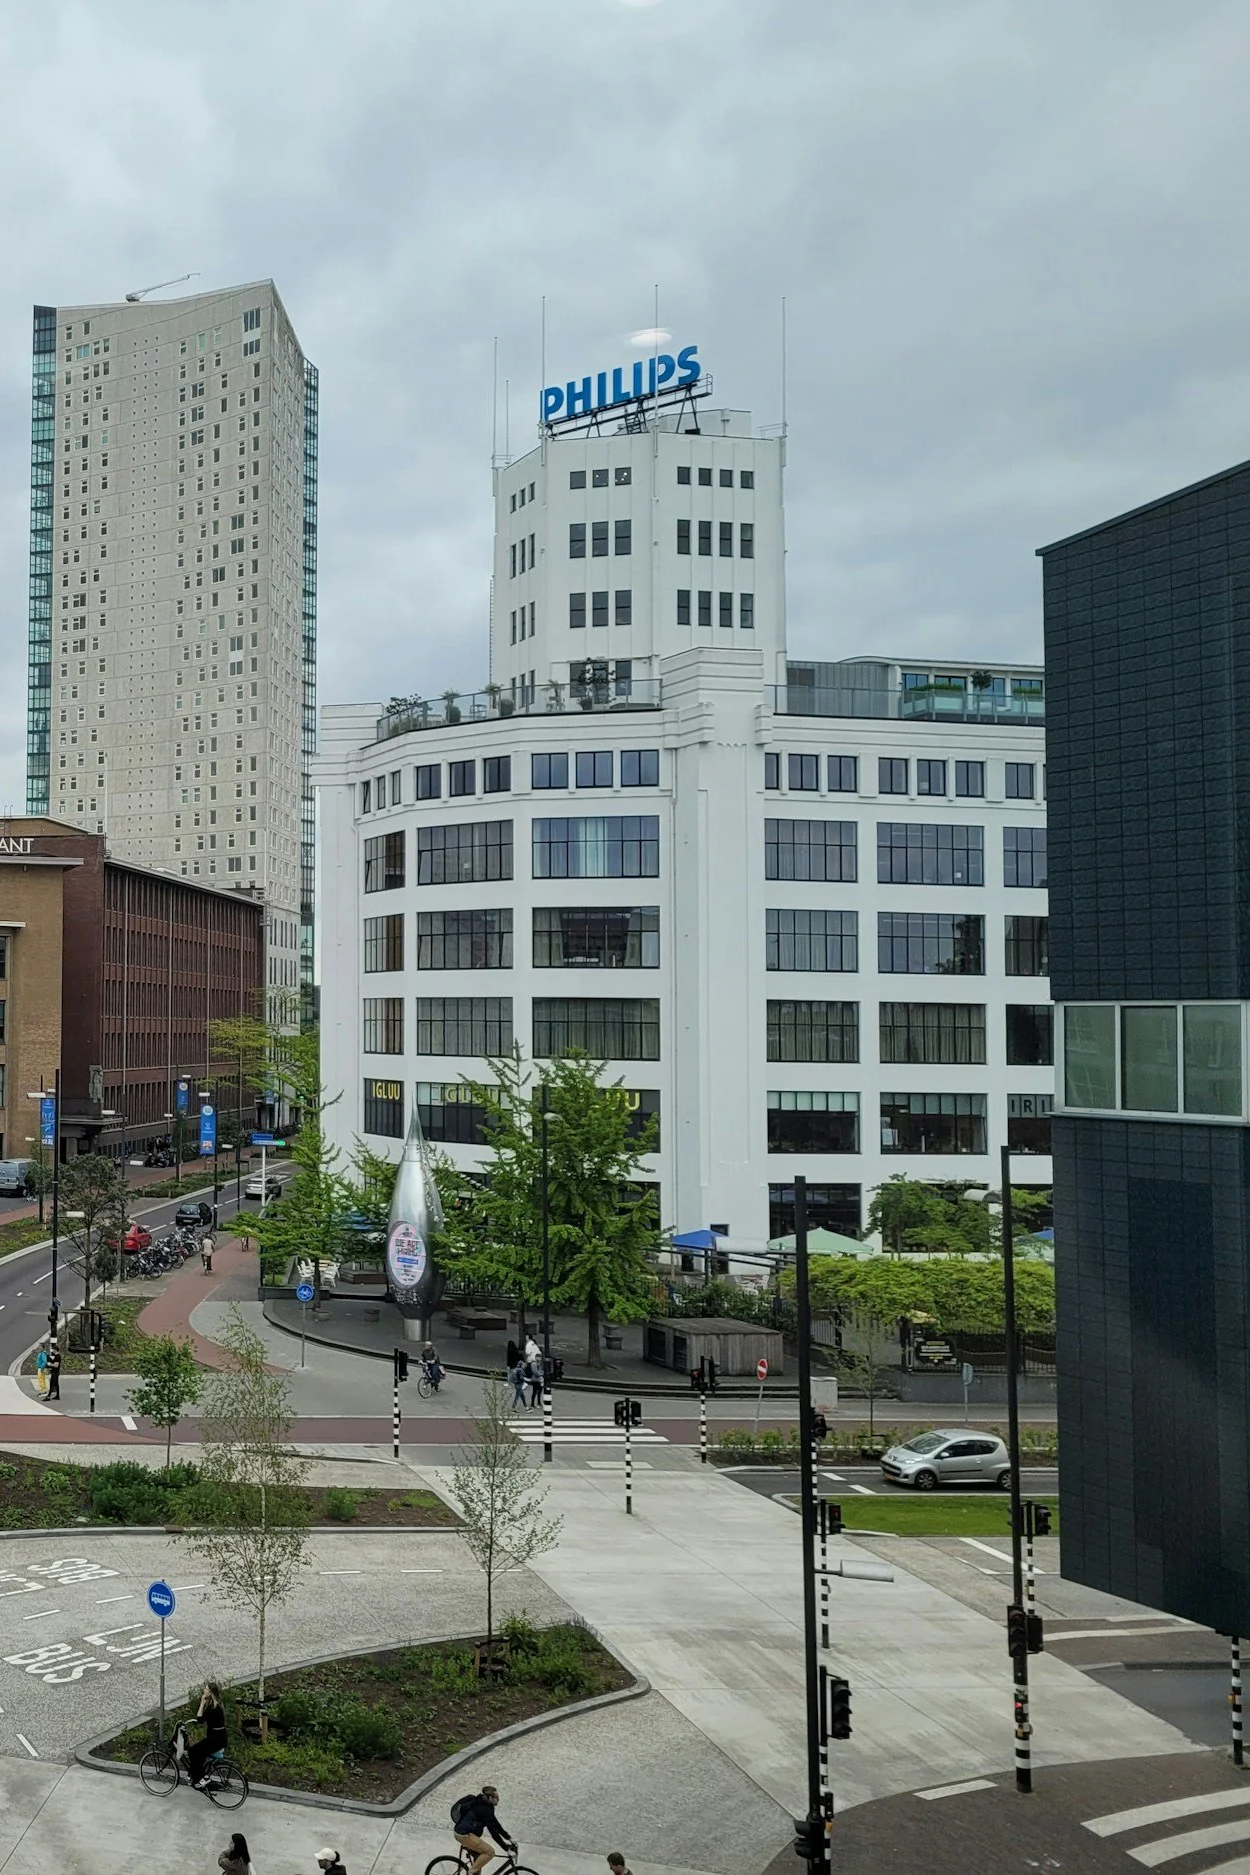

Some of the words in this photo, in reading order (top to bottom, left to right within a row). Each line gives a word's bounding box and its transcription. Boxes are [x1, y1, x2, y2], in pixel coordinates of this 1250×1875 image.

[540, 345, 702, 423] PHILIPS
[372, 1081, 401, 1101] IGLUU
[439, 1087, 499, 1105] IGLU
[27, 1557, 121, 1585] BUS
[2, 1642, 112, 1684] BUS
